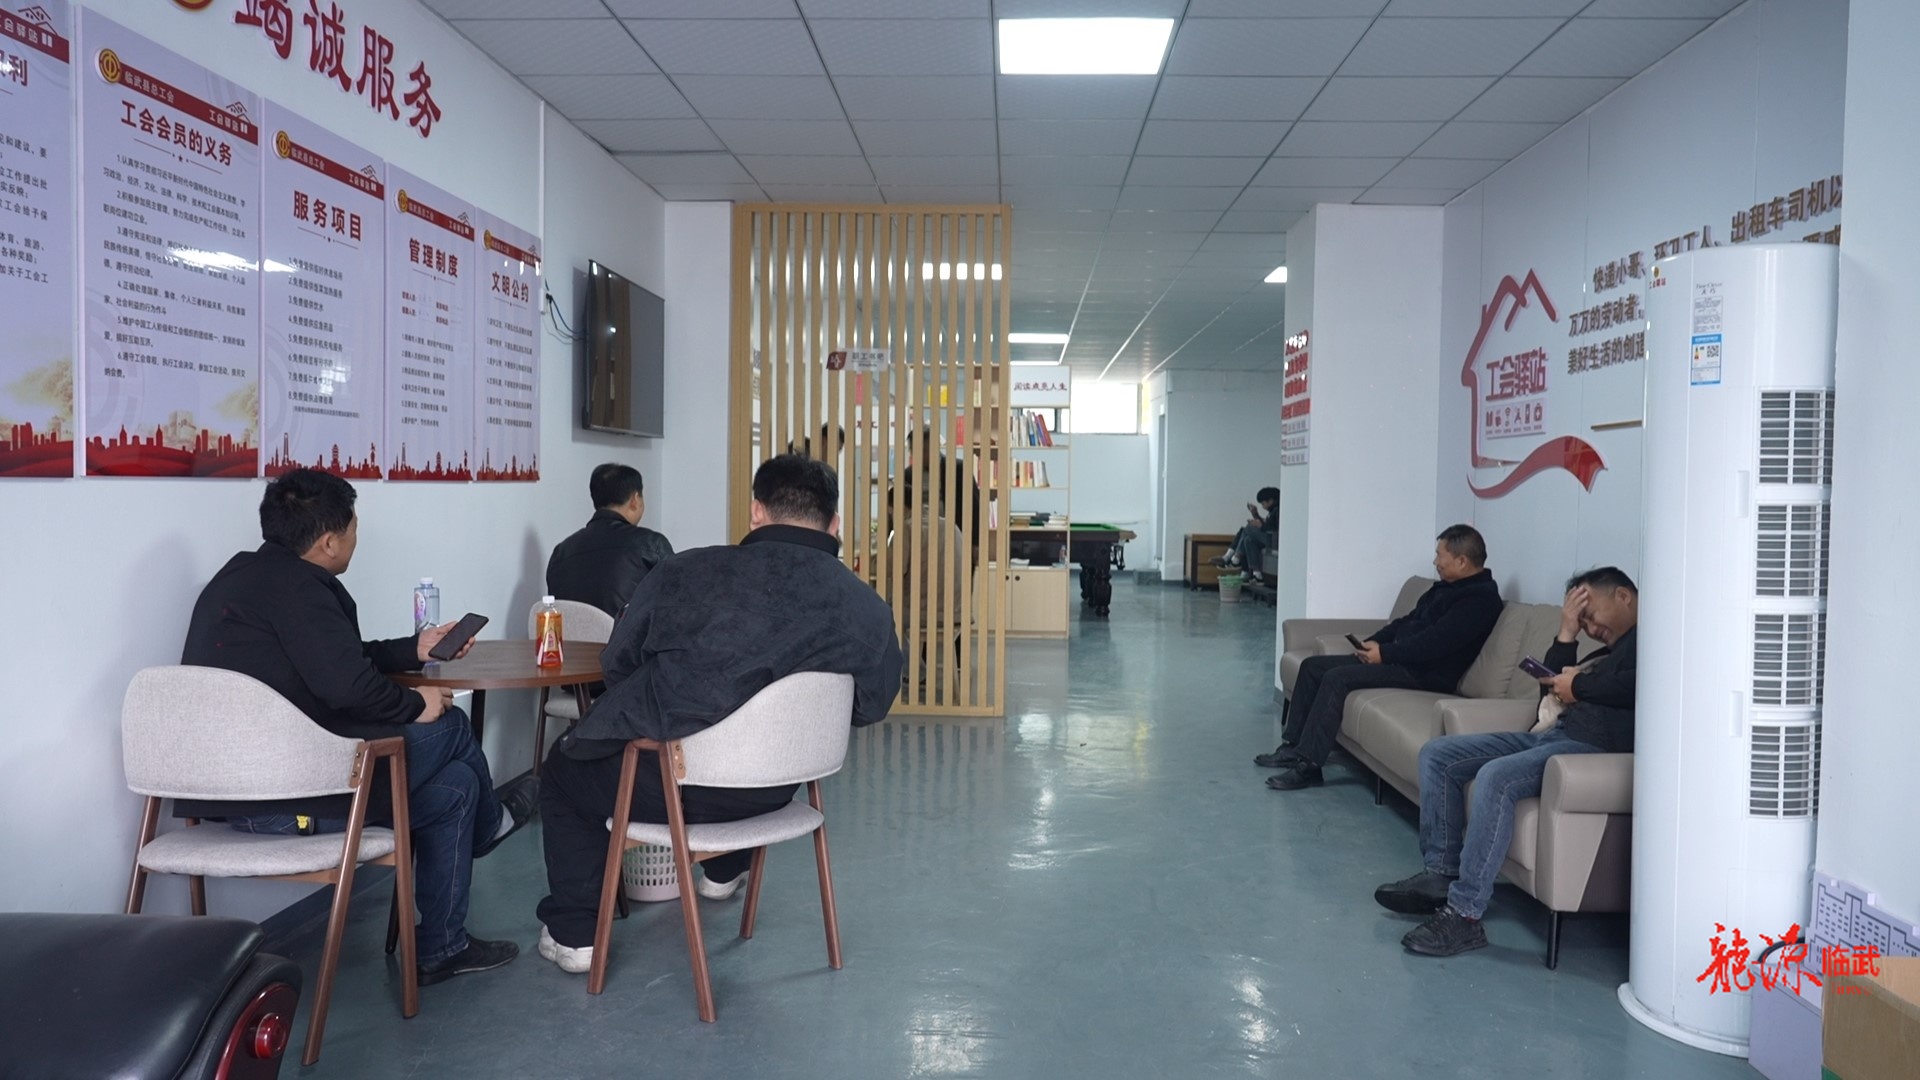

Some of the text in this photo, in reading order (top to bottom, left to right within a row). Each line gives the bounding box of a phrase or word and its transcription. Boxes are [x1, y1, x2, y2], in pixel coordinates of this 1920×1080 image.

[124, 70, 175, 104] 临武县总工会
[121, 100, 232, 166] 工会会员的义务
[209, 108, 240, 133] 工会驿站
[293, 190, 362, 241] 服务项目
[410, 237, 458, 278] 管理制度
[492, 272, 528, 303] 文明公约
[1486, 347, 1547, 402] 工会驿站
